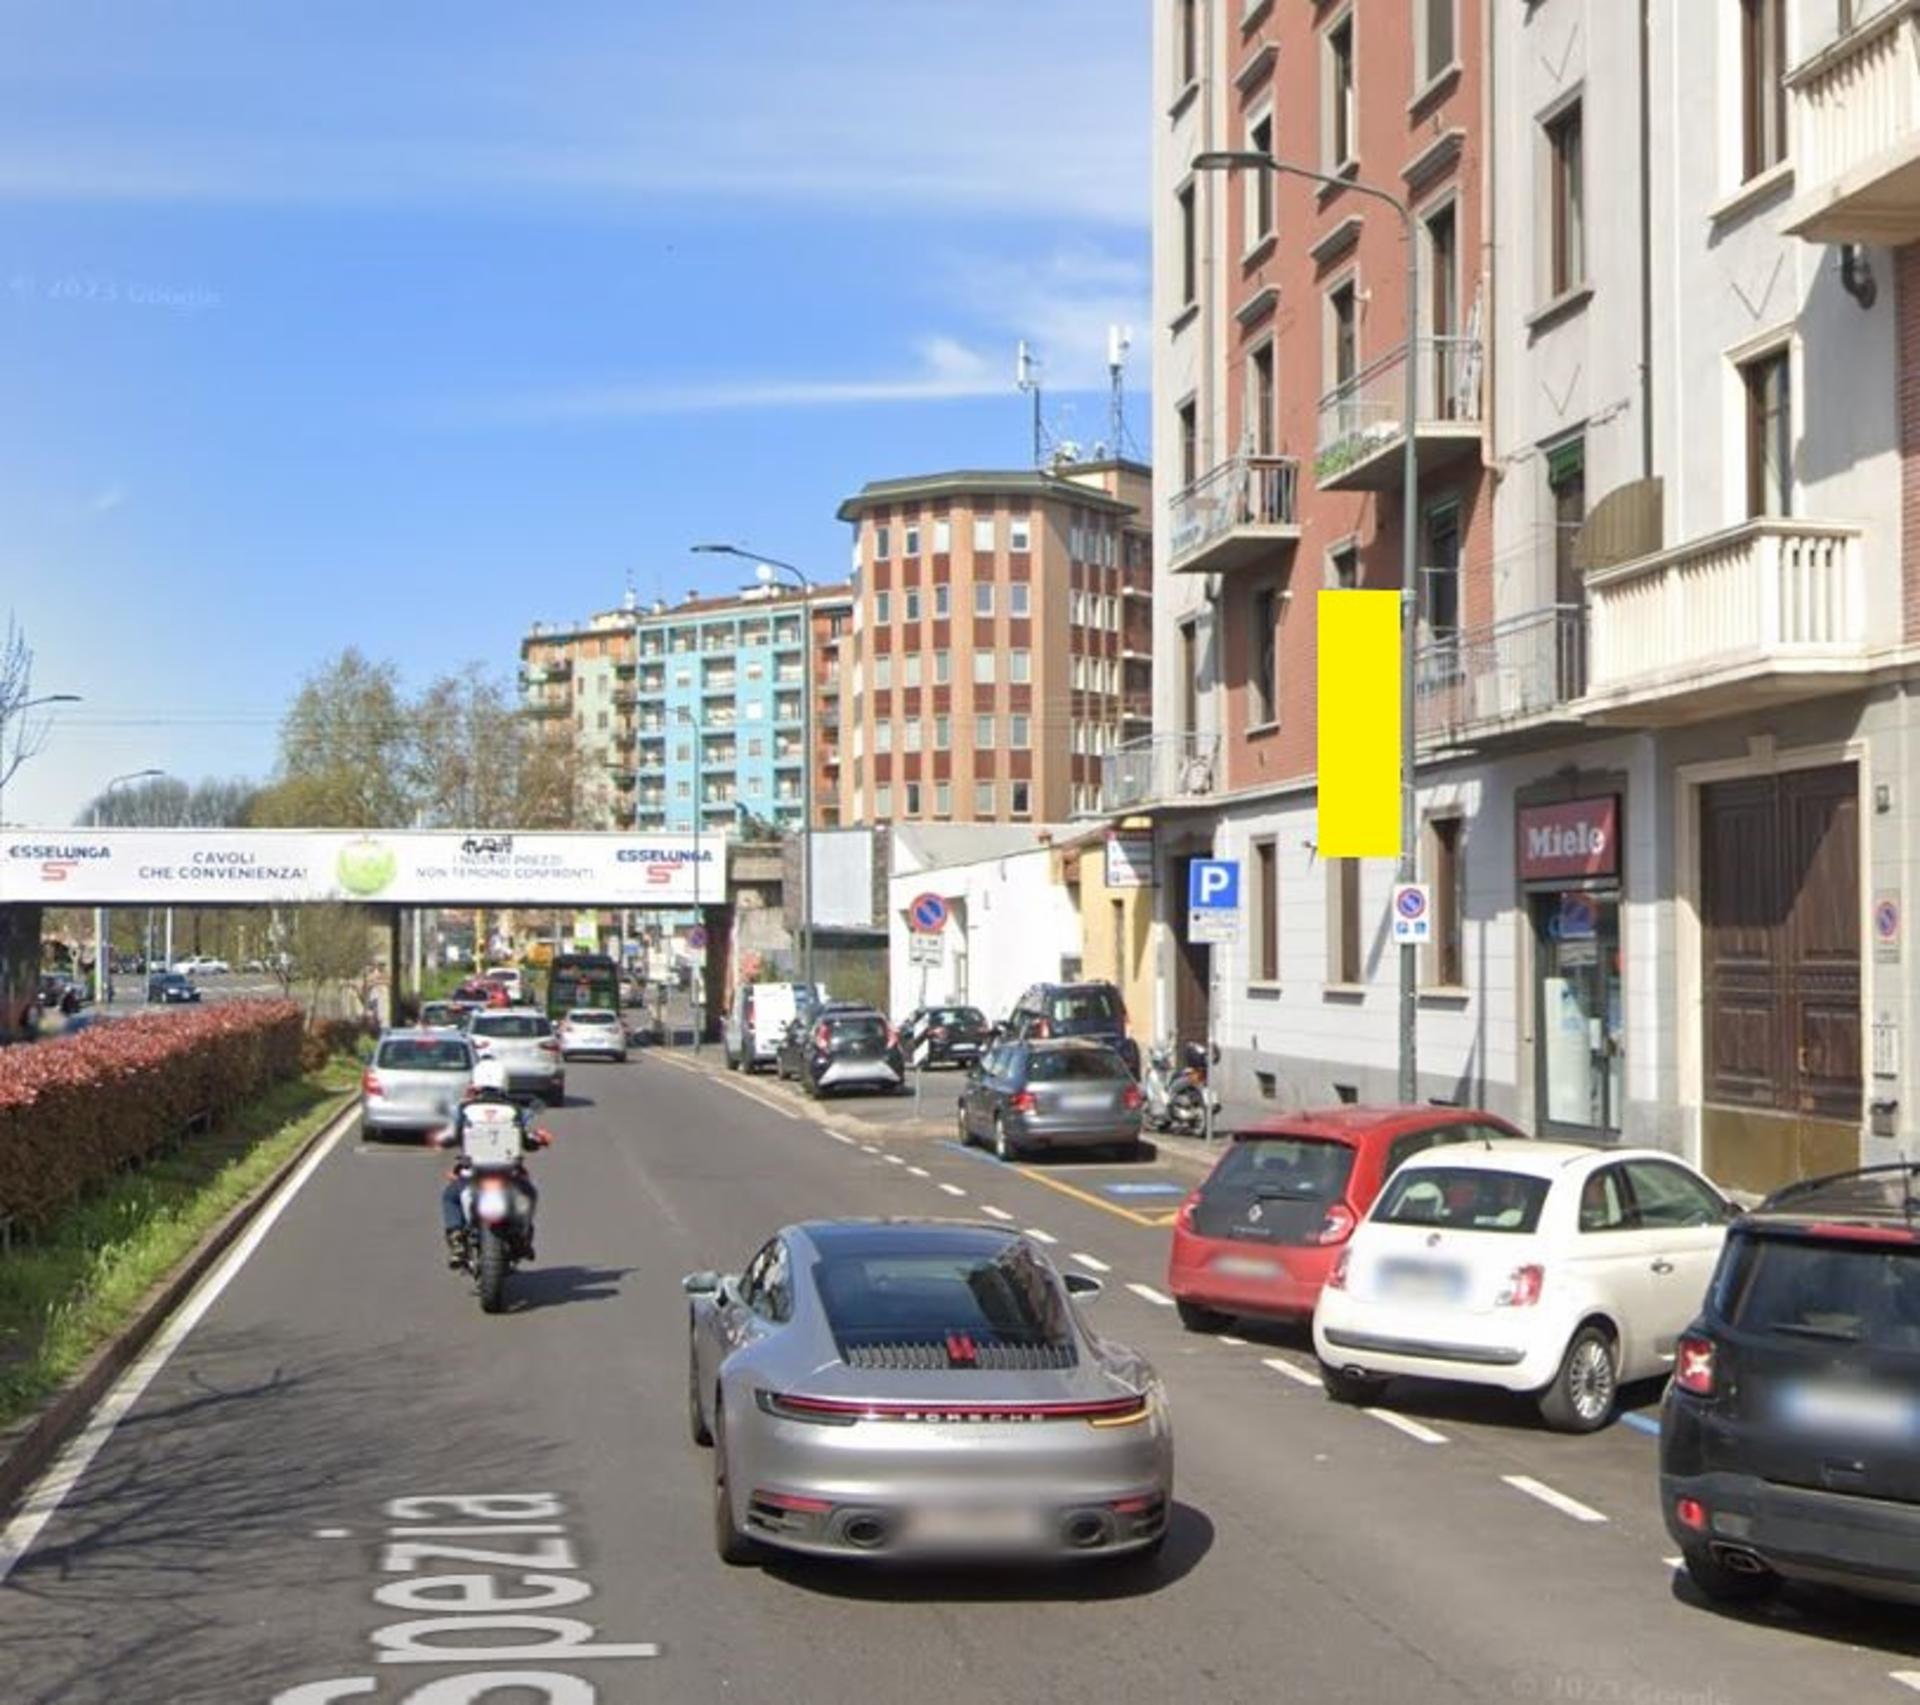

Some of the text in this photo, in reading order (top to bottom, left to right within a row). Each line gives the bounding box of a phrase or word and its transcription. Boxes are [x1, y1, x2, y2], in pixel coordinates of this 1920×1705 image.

[1526, 821, 1606, 860] Miele
[9, 844, 112, 859] ESSELUNGA
[192, 851, 255, 865] CAVOLI
[615, 848, 714, 863] ESSELUNGA
[138, 866, 308, 880] CHE CONVENIENZA!
[1200, 865, 1230, 903] P
[904, 1412, 1045, 1423] PORSCHE
